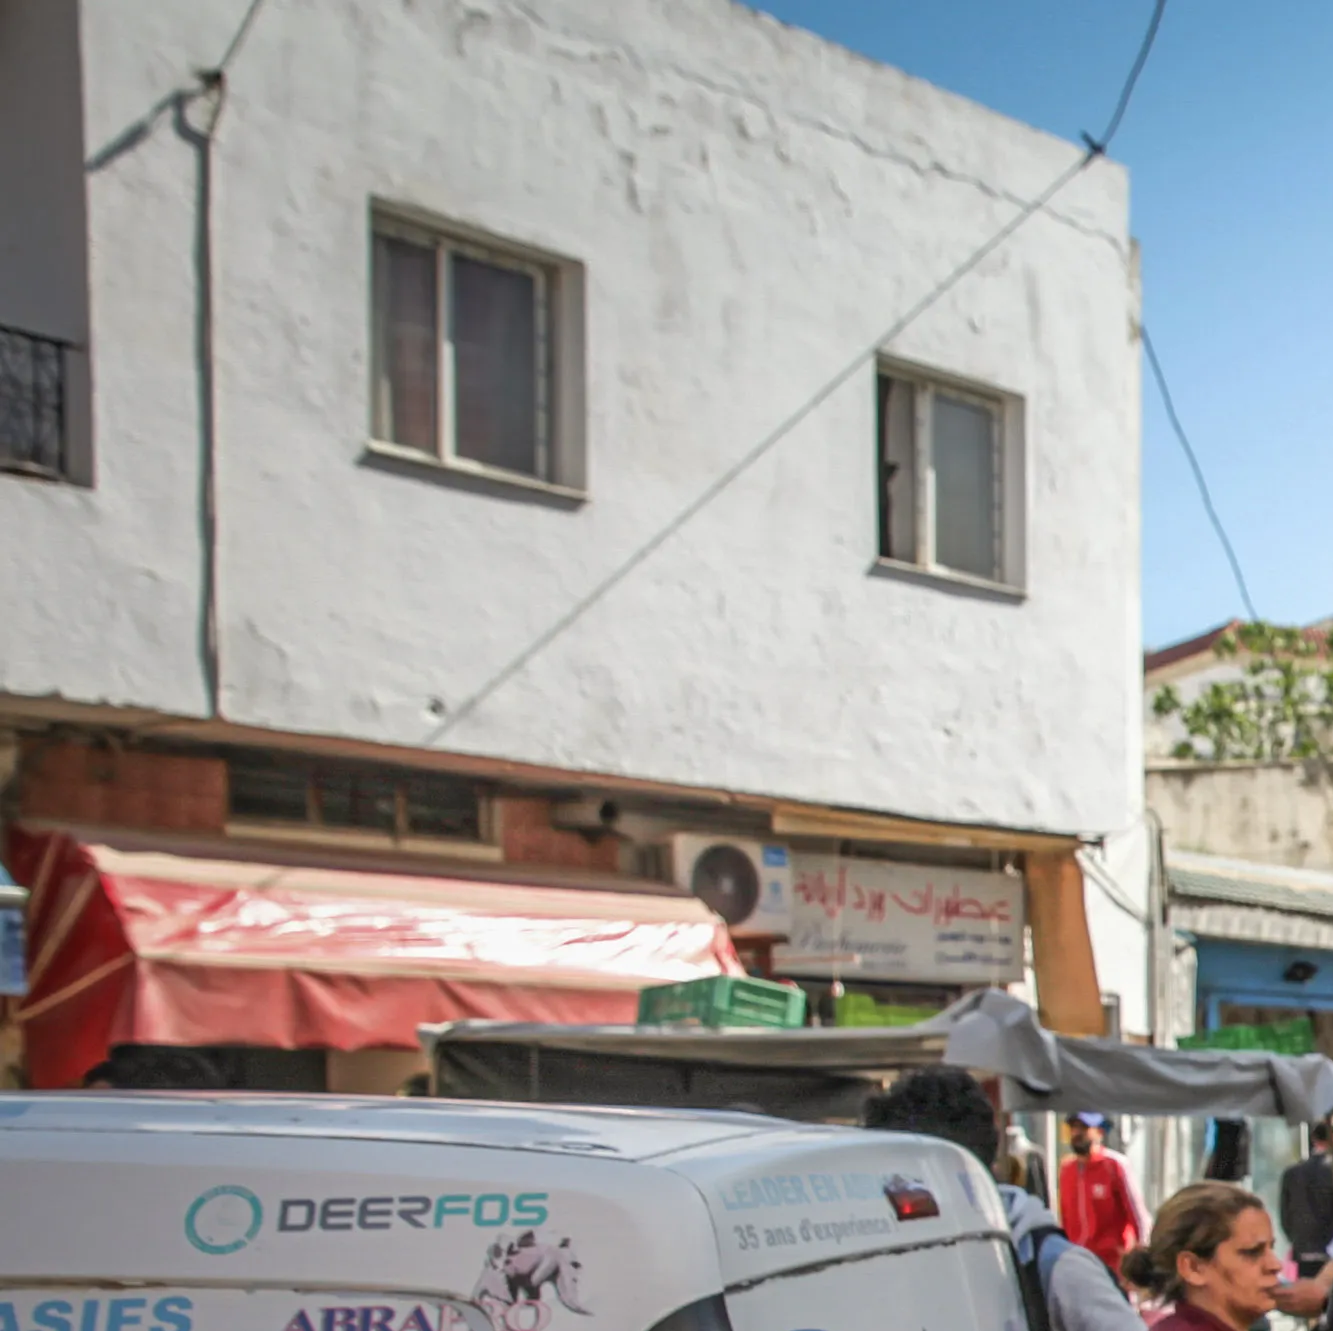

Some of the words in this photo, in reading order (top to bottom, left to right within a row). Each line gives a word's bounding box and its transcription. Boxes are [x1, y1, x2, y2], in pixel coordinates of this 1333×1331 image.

[276, 1192, 549, 1233] DEERFOS
[734, 1223, 760, 1251] 35
[763, 1224, 795, 1248] ans
